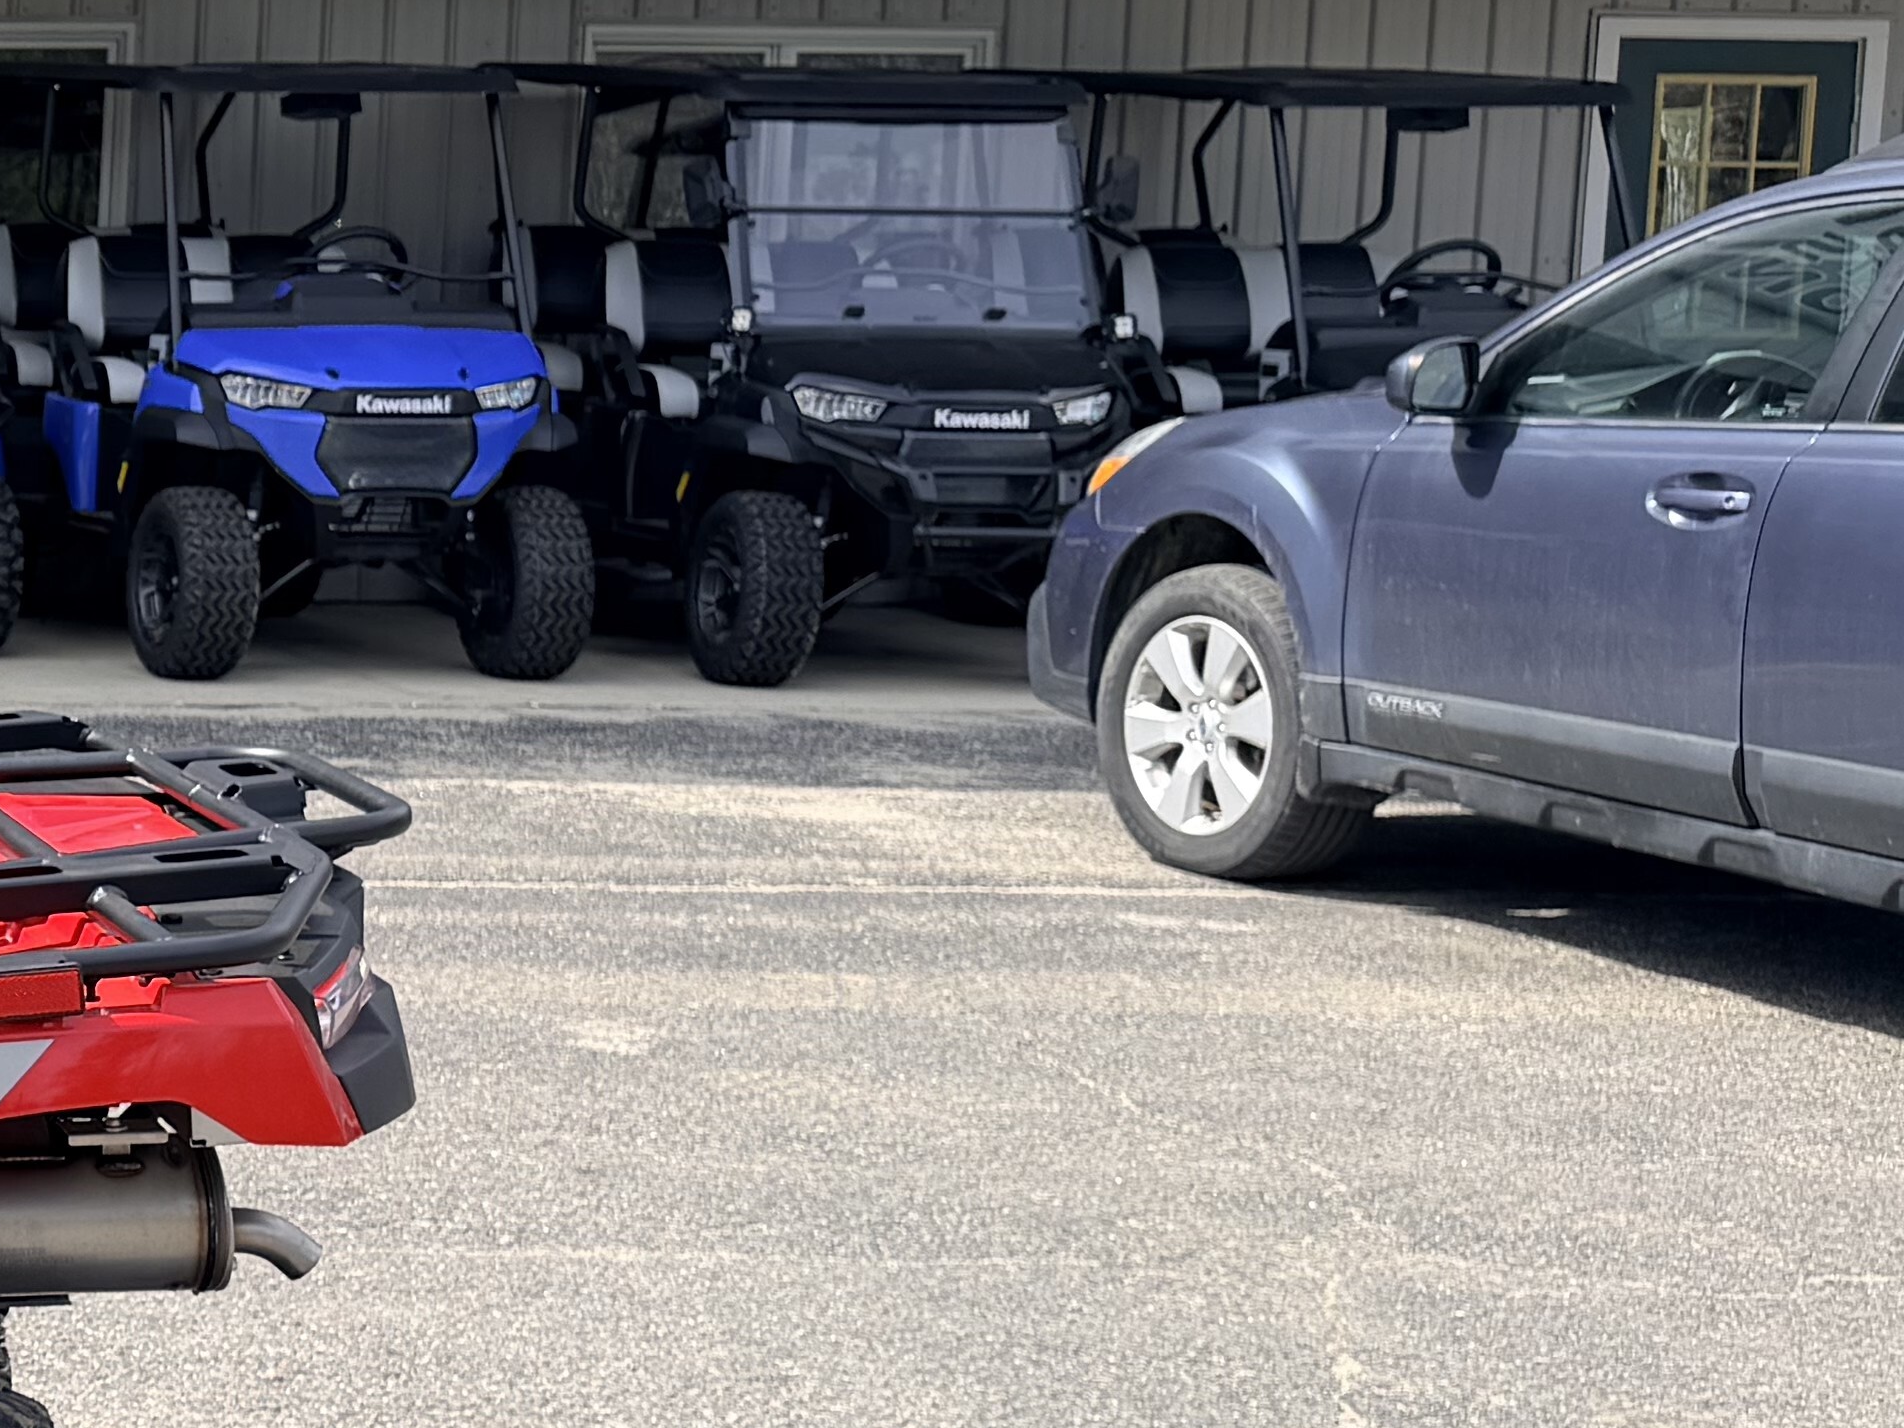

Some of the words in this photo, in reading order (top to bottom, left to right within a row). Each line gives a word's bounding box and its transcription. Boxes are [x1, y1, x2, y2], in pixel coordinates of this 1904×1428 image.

[356, 394, 452, 414] Kawasaki
[934, 408, 1030, 429] Kawasaki
[1367, 692, 1444, 718] OUTBACK
